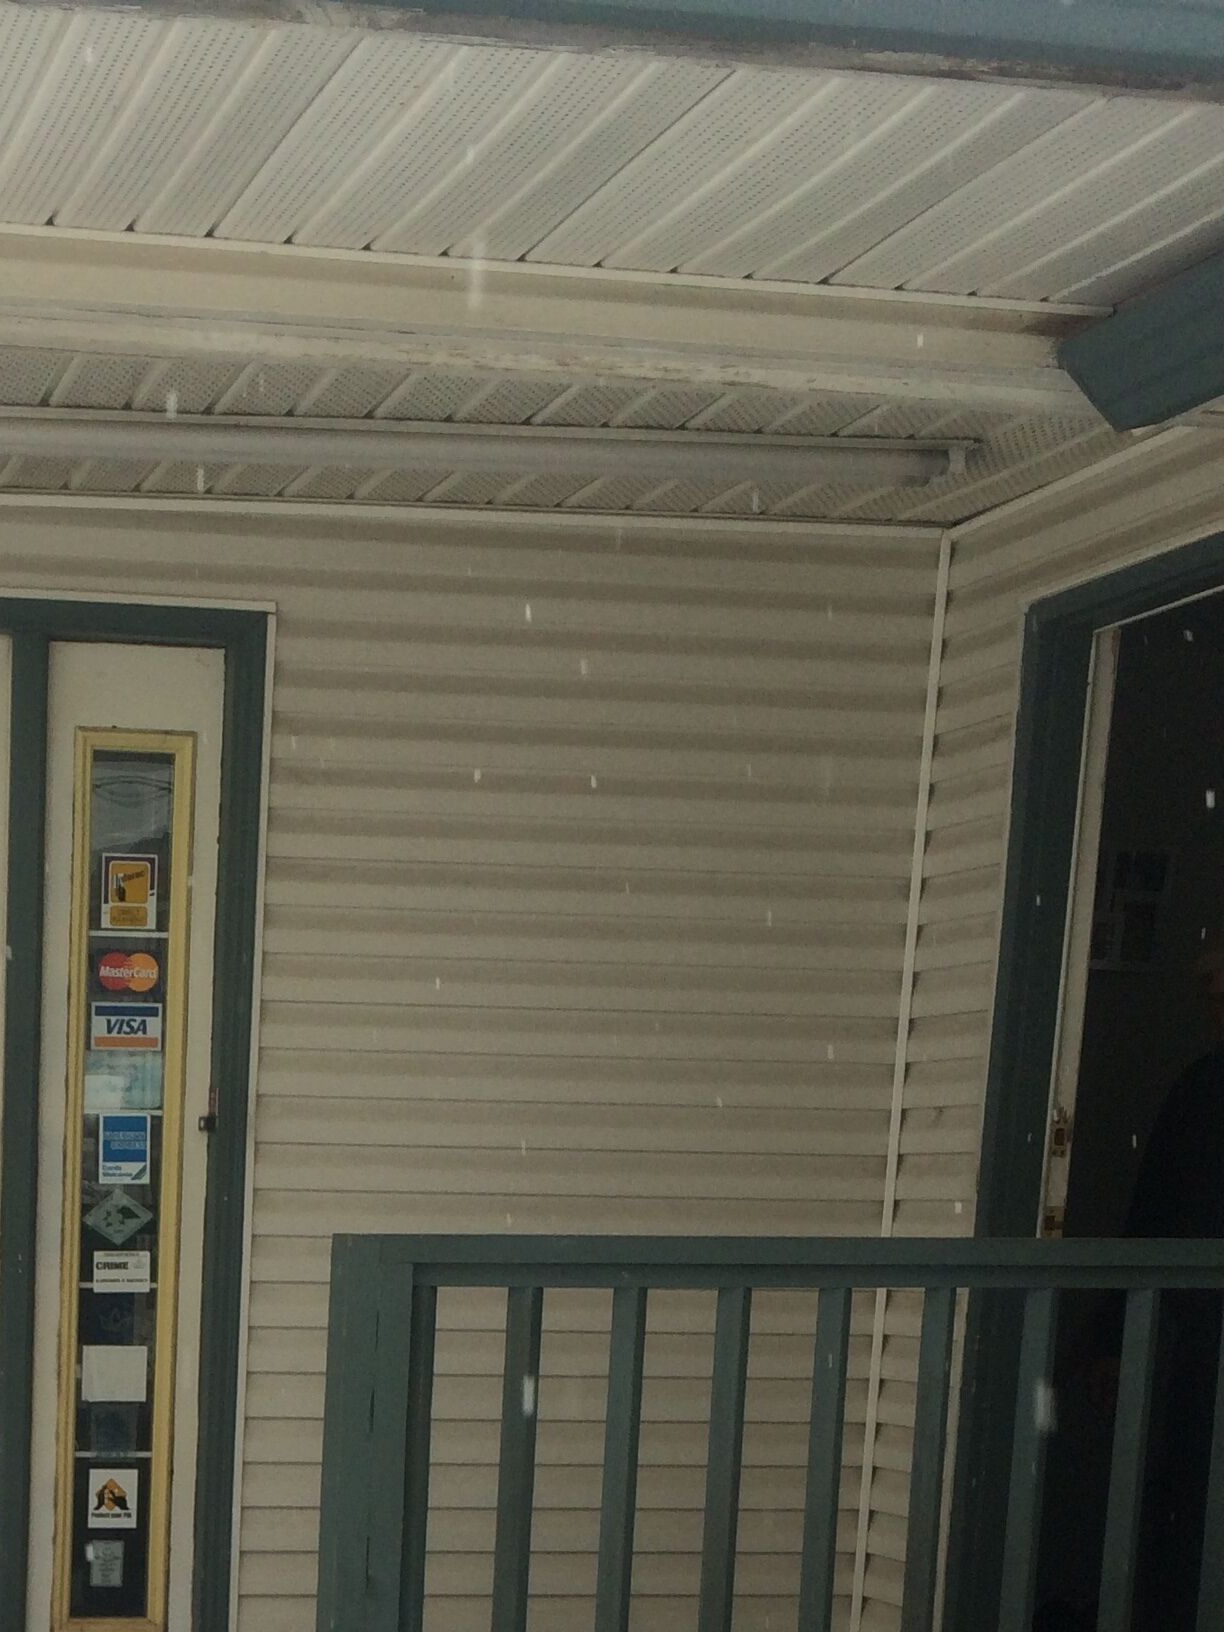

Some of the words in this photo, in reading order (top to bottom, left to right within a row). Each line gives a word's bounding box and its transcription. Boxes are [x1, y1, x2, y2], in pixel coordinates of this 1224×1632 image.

[99, 965, 158, 980] MasterCard
[104, 1017, 149, 1036] VISA
[95, 1261, 129, 1270] CRIME
